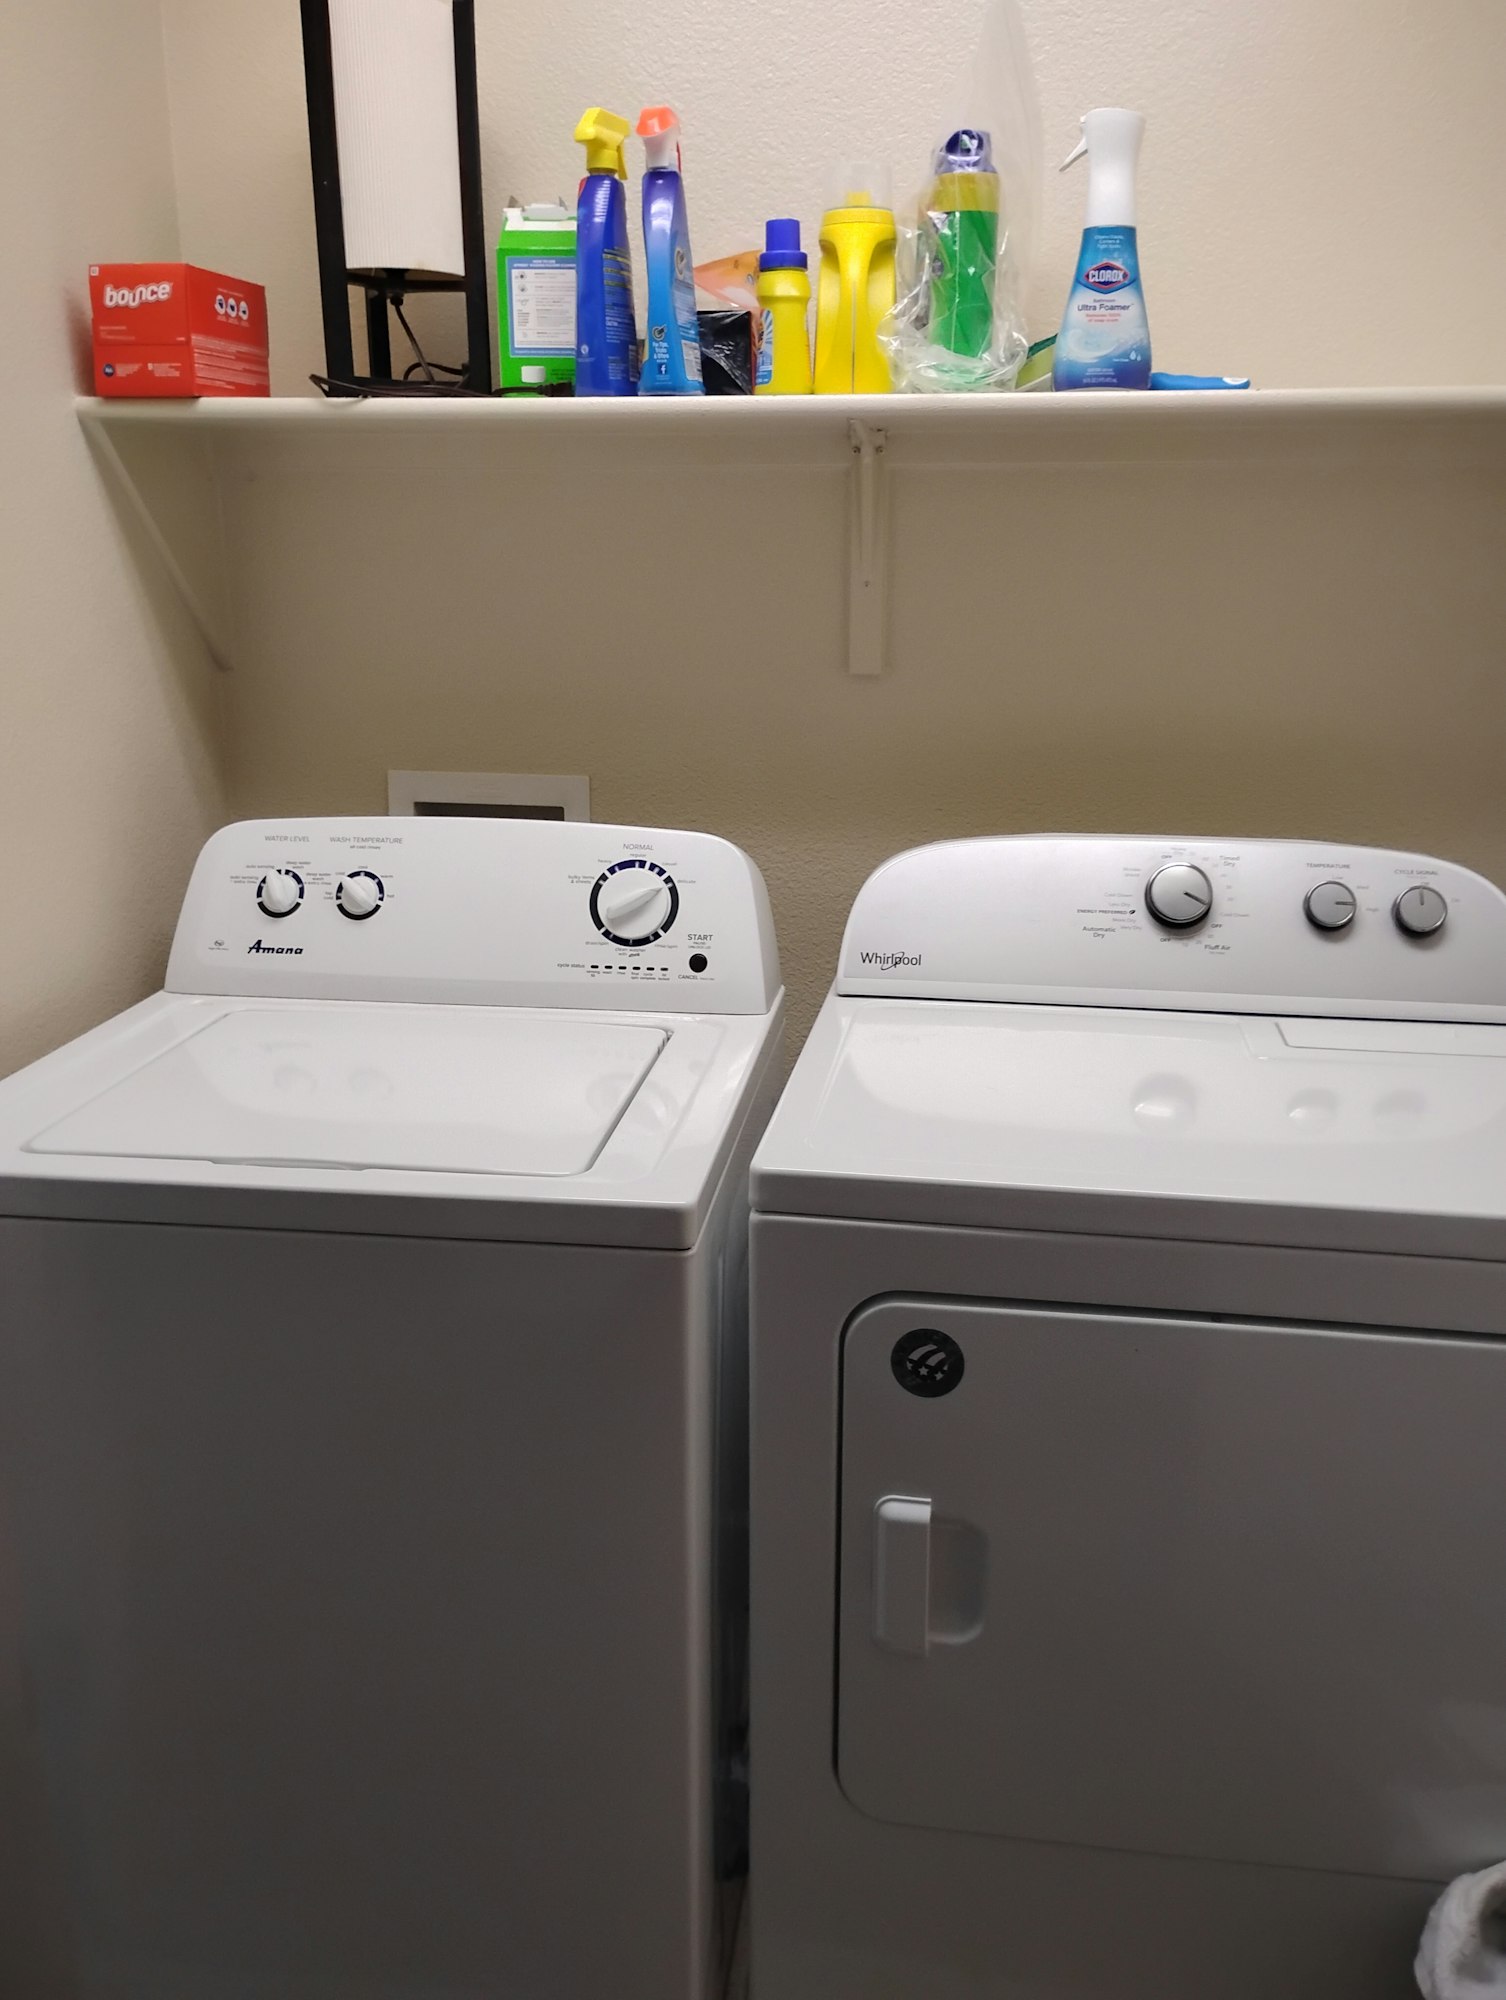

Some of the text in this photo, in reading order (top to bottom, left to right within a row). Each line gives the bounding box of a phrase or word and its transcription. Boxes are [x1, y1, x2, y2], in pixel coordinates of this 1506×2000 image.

[1088, 269, 1124, 283] CLOROX
[103, 281, 171, 308] bounce
[1077, 304, 1097, 312] Ultra
[264, 835, 288, 843] WATER
[329, 836, 404, 845] WASH TEMPERATURE
[622, 843, 654, 851] NORMAL
[1082, 926, 1117, 934] Automatic
[687, 933, 714, 942] START
[247, 939, 304, 955] Amana
[860, 951, 922, 971] Whirlpool
